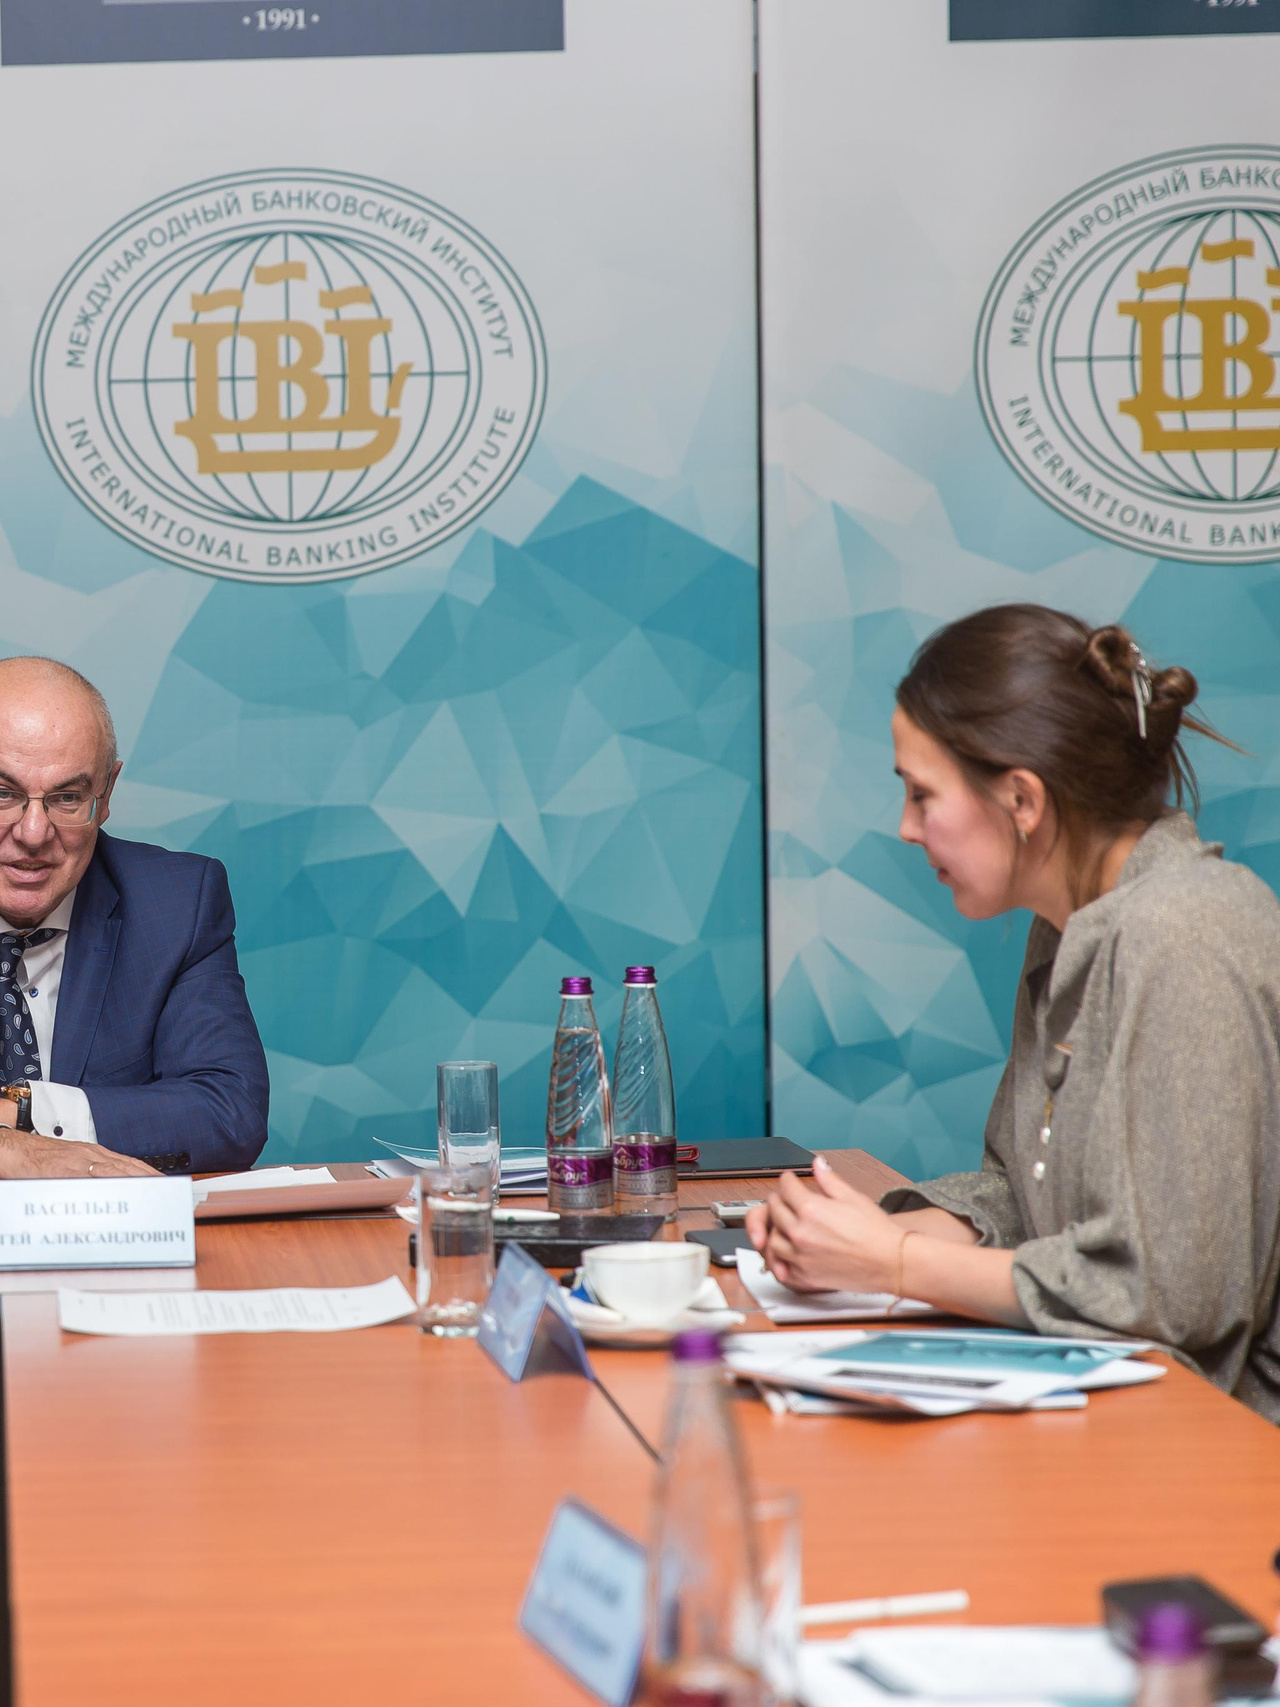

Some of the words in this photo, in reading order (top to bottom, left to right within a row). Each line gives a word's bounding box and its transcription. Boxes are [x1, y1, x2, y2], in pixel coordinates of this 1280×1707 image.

[65, 189, 242, 369] МЕЖДУНАРОДНЫЙ
[252, 189, 431, 244] БАНКОВСКИЙ
[431, 236, 514, 359] ИНСТИТУТ
[1009, 166, 1191, 347] МЕЖДУНАРОДНЫЙ
[65, 416, 250, 564] INTERNATIONAL
[266, 526, 399, 567] BANKING
[408, 406, 516, 534] INSTITUTE
[1008, 395, 1192, 544] INTERNATIONAL
[24, 1201, 129, 1216] ВАСИЛЬЕВ
[40, 1230, 186, 1245] АЛЕКСАНДРОВИЧ
